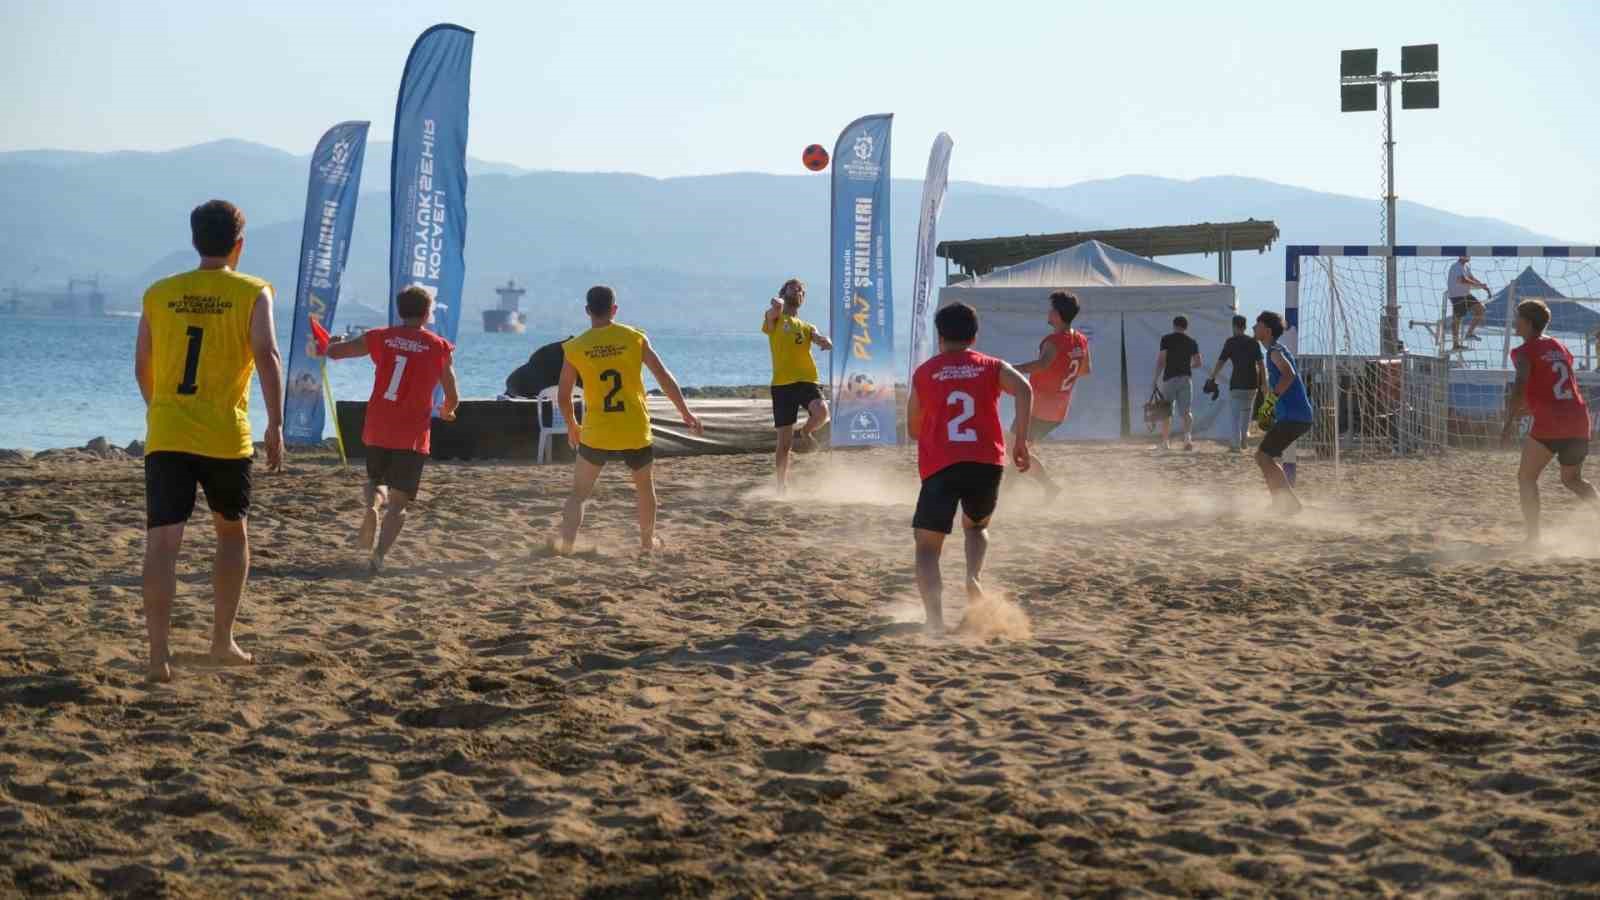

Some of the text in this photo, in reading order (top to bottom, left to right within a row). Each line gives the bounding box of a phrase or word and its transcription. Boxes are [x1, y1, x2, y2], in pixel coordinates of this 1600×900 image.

[854, 197, 873, 288] ŞENLİKLERİ
[794, 332, 803, 345] 2
[853, 290, 872, 361] PLAJ
[177, 326, 204, 395] 1
[383, 354, 408, 401] 1
[1060, 359, 1079, 391] 2
[1552, 361, 1574, 400] 2
[599, 368, 625, 412] 2
[946, 390, 978, 442] 2
